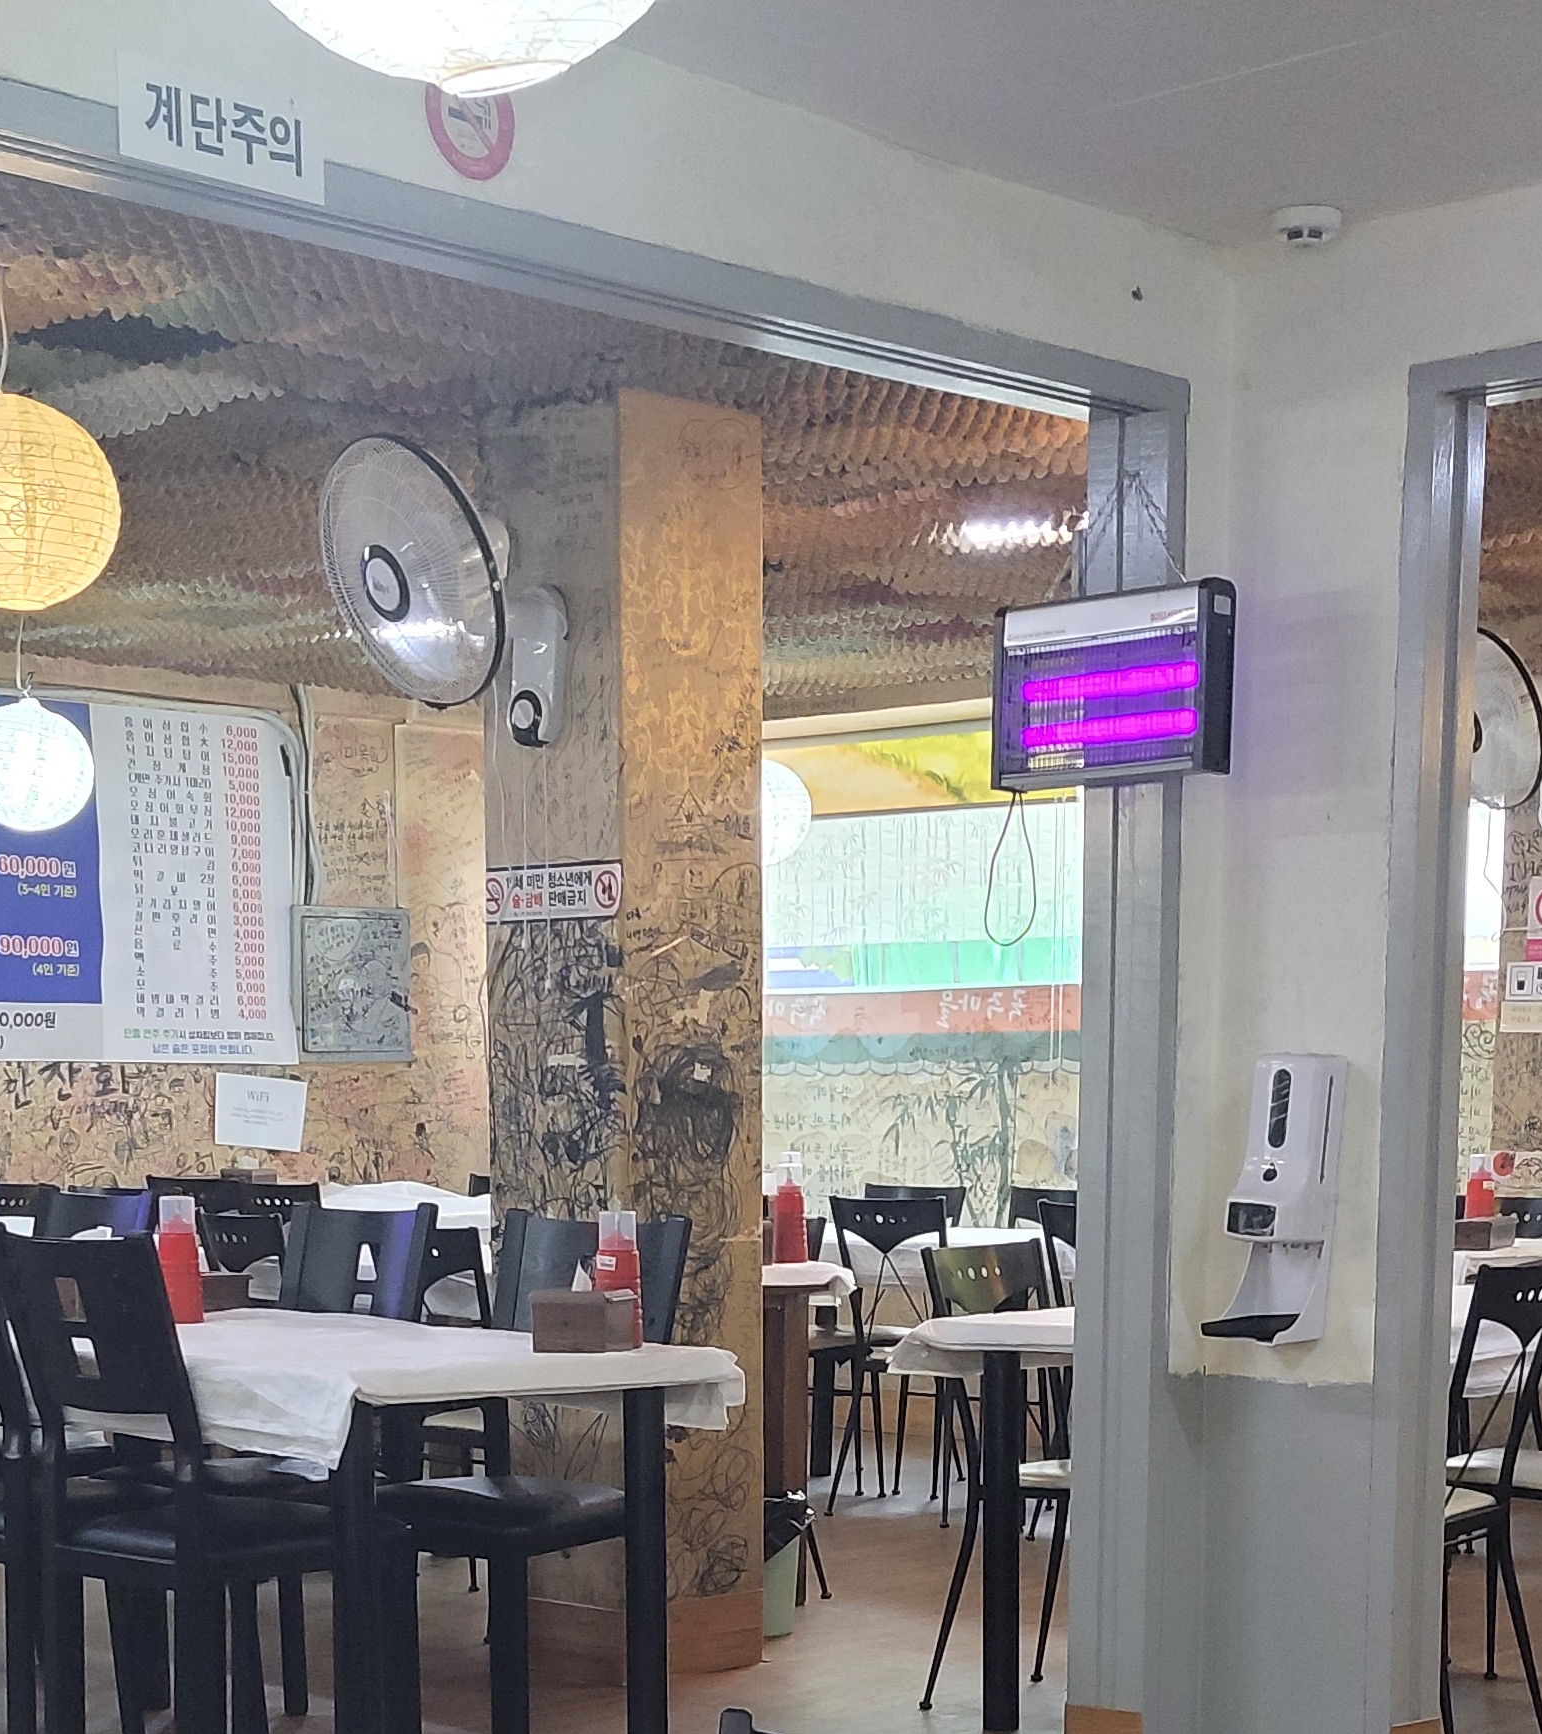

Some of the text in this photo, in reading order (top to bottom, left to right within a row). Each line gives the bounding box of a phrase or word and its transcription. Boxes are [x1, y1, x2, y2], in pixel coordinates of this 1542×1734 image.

[144, 82, 303, 178] 계단주의
[226, 725, 257, 739] 6,000
[221, 739, 258, 753] 12,000
[222, 752, 259, 766] 15,000
[223, 766, 260, 780] 10,000
[229, 780, 260, 794] 5,000
[224, 793, 261, 807] 10,000
[225, 807, 261, 821] 12,000
[226, 820, 261, 834] 10,000
[231, 848, 261, 861] 7,000
[526, 873, 544, 891] 미만
[548, 870, 592, 888] 청소년에게
[54, 883, 77, 898] 기준)
[234, 928, 264, 941] 4,000
[235, 942, 264, 954] 2,000
[235, 955, 264, 968] 5,000
[32, 962, 80, 978] (4인 기준)
[236, 969, 264, 981] 5,000
[237, 982, 265, 994] 6,000
[238, 995, 266, 1008] 6,000
[238, 1008, 266, 1021] 4,000
[247, 1090, 270, 1103] WiFi
